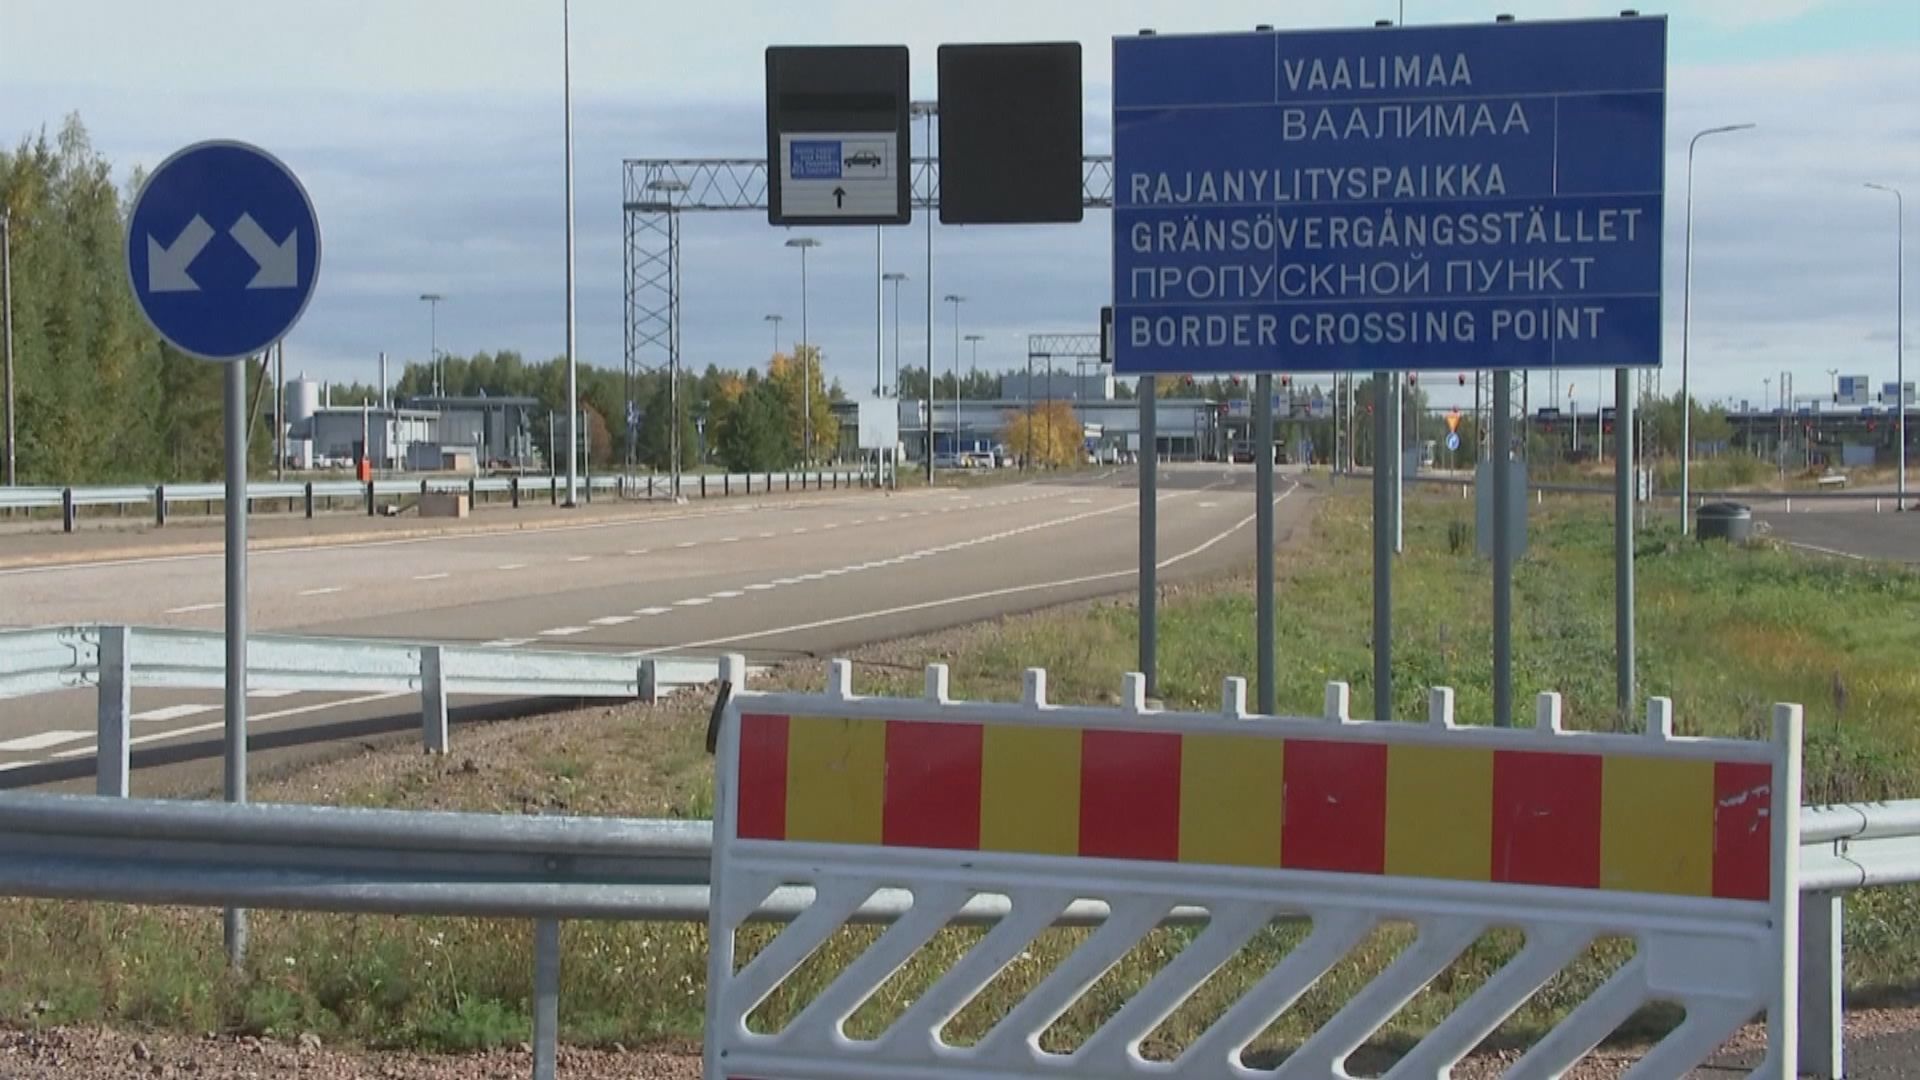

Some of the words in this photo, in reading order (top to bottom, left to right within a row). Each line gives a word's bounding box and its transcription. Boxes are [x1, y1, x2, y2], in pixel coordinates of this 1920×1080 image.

[1284, 53, 1472, 91] VAALIMAA
[1283, 102, 1530, 140] ВААЛИМАА
[1131, 164, 1506, 204] RAJANYLITYSPAIKKA
[1131, 208, 1642, 252] GRÄNSÖVERGÅNGSSTÄLLET
[1131, 253, 1430, 298] ПРОПУСКНОЙ
[1446, 258, 1594, 293] ПУНКТ
[1131, 314, 1277, 348] BORDER
[1290, 310, 1475, 344] CROSSING
[1493, 307, 1605, 340] POINT
